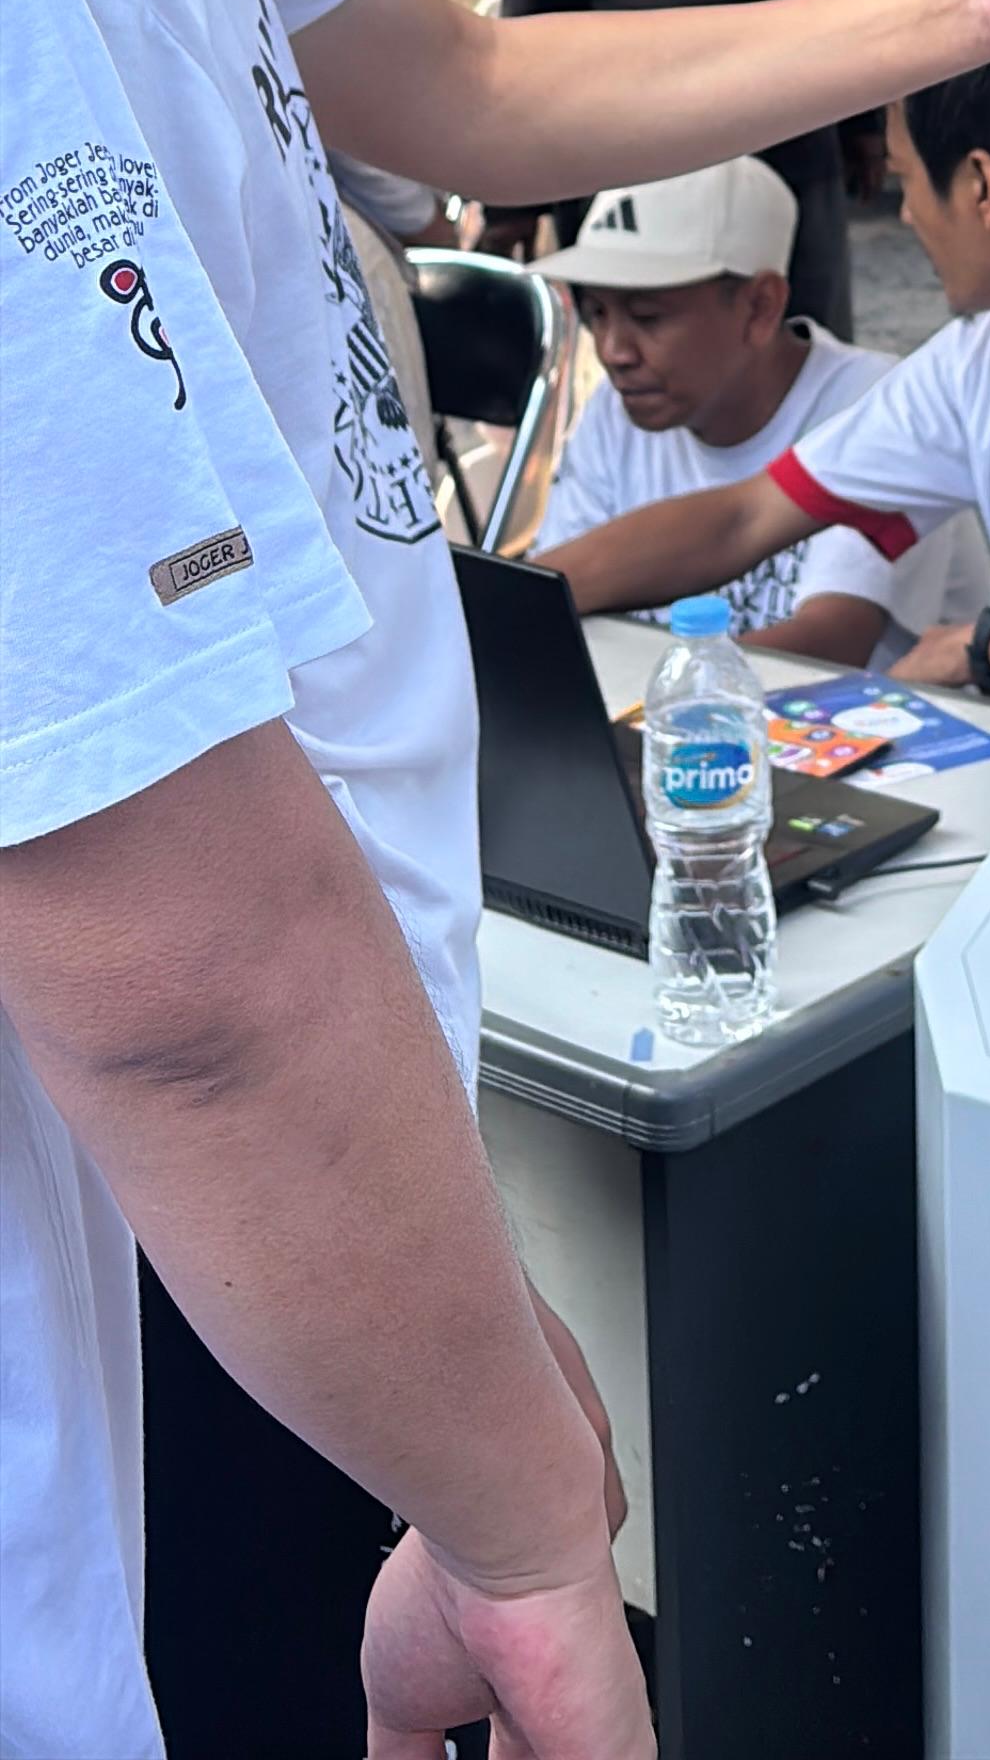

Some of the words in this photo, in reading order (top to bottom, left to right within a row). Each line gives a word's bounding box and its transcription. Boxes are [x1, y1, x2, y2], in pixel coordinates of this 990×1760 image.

[35, 150, 82, 184] Joger
[5, 167, 108, 235] Sering-sering
[18, 191, 98, 254] banyaklah
[43, 225, 92, 261] dunia,
[70, 234, 120, 269] besar
[182, 544, 235, 581] JOGER
